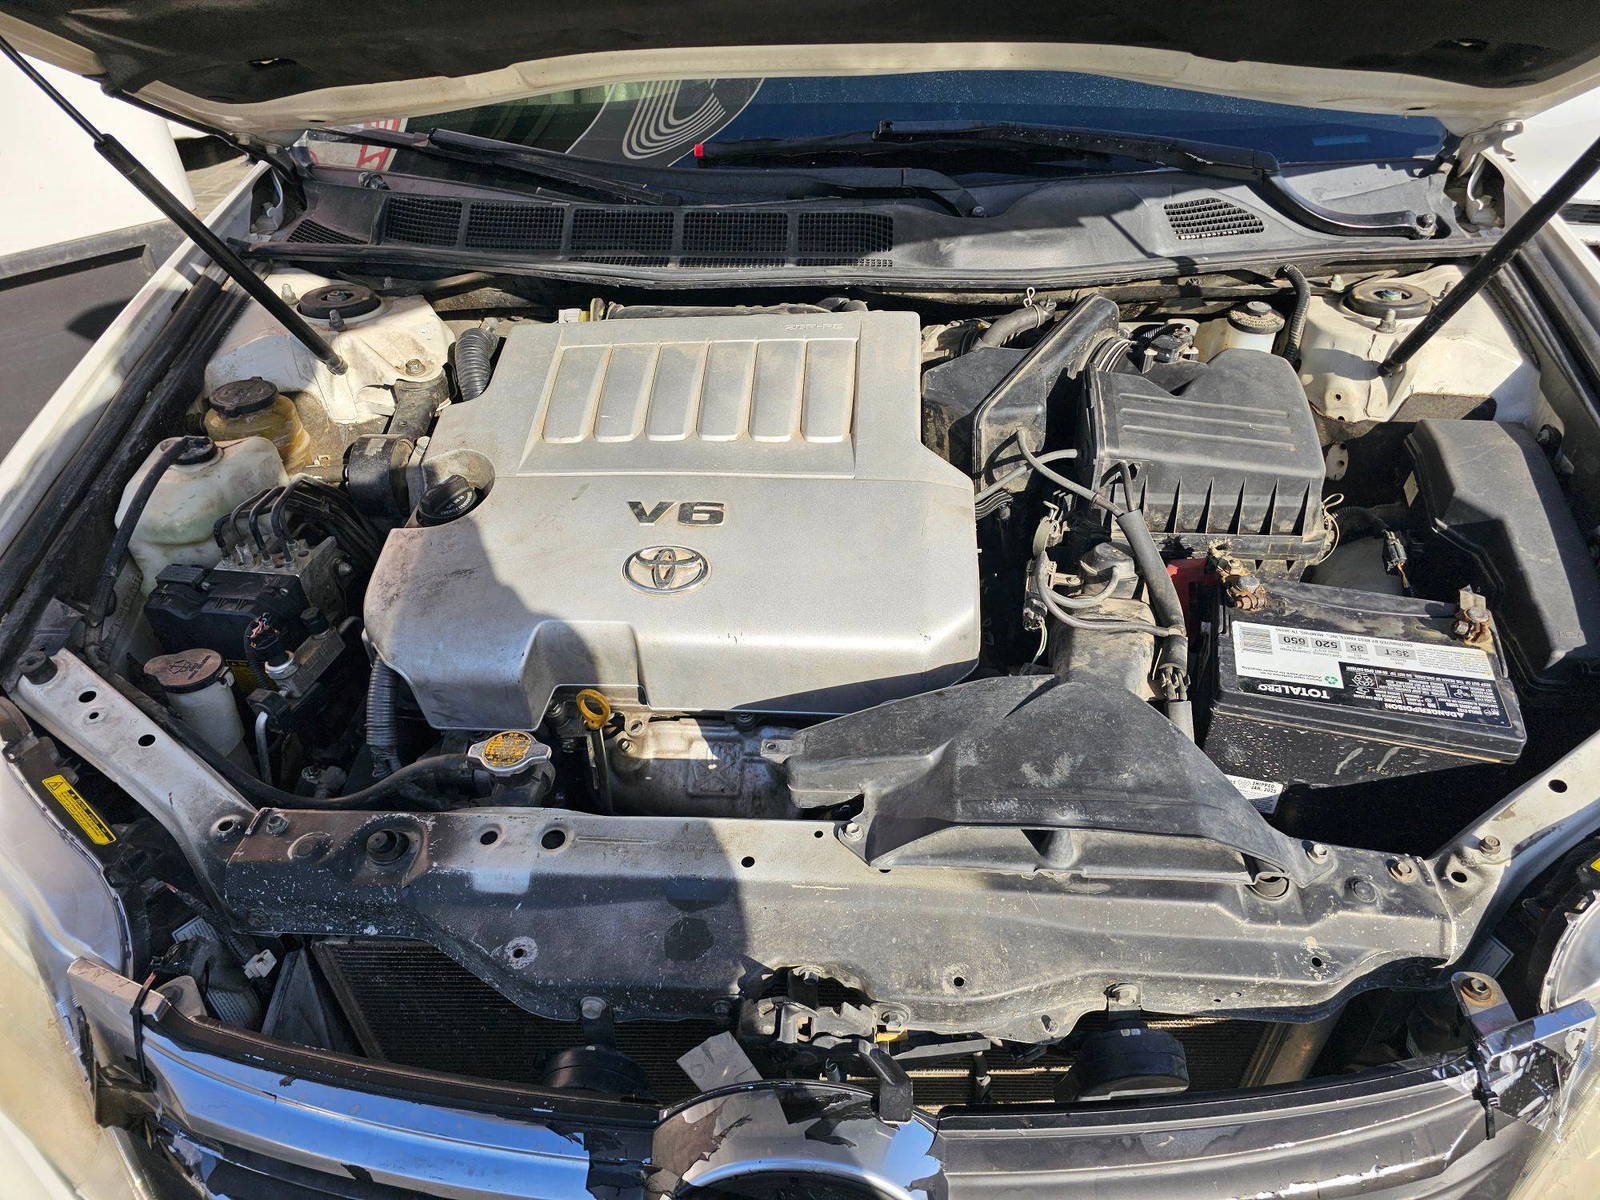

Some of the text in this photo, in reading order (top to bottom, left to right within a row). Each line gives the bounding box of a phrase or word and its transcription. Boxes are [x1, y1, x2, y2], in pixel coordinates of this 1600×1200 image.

[627, 501, 725, 525] V6
[1283, 636, 1305, 645] 650
[1315, 639, 1338, 649] 520
[1350, 644, 1364, 652] 35
[1258, 684, 1330, 699] TOTALPRO
[1252, 781, 1275, 789] SHIPPED
